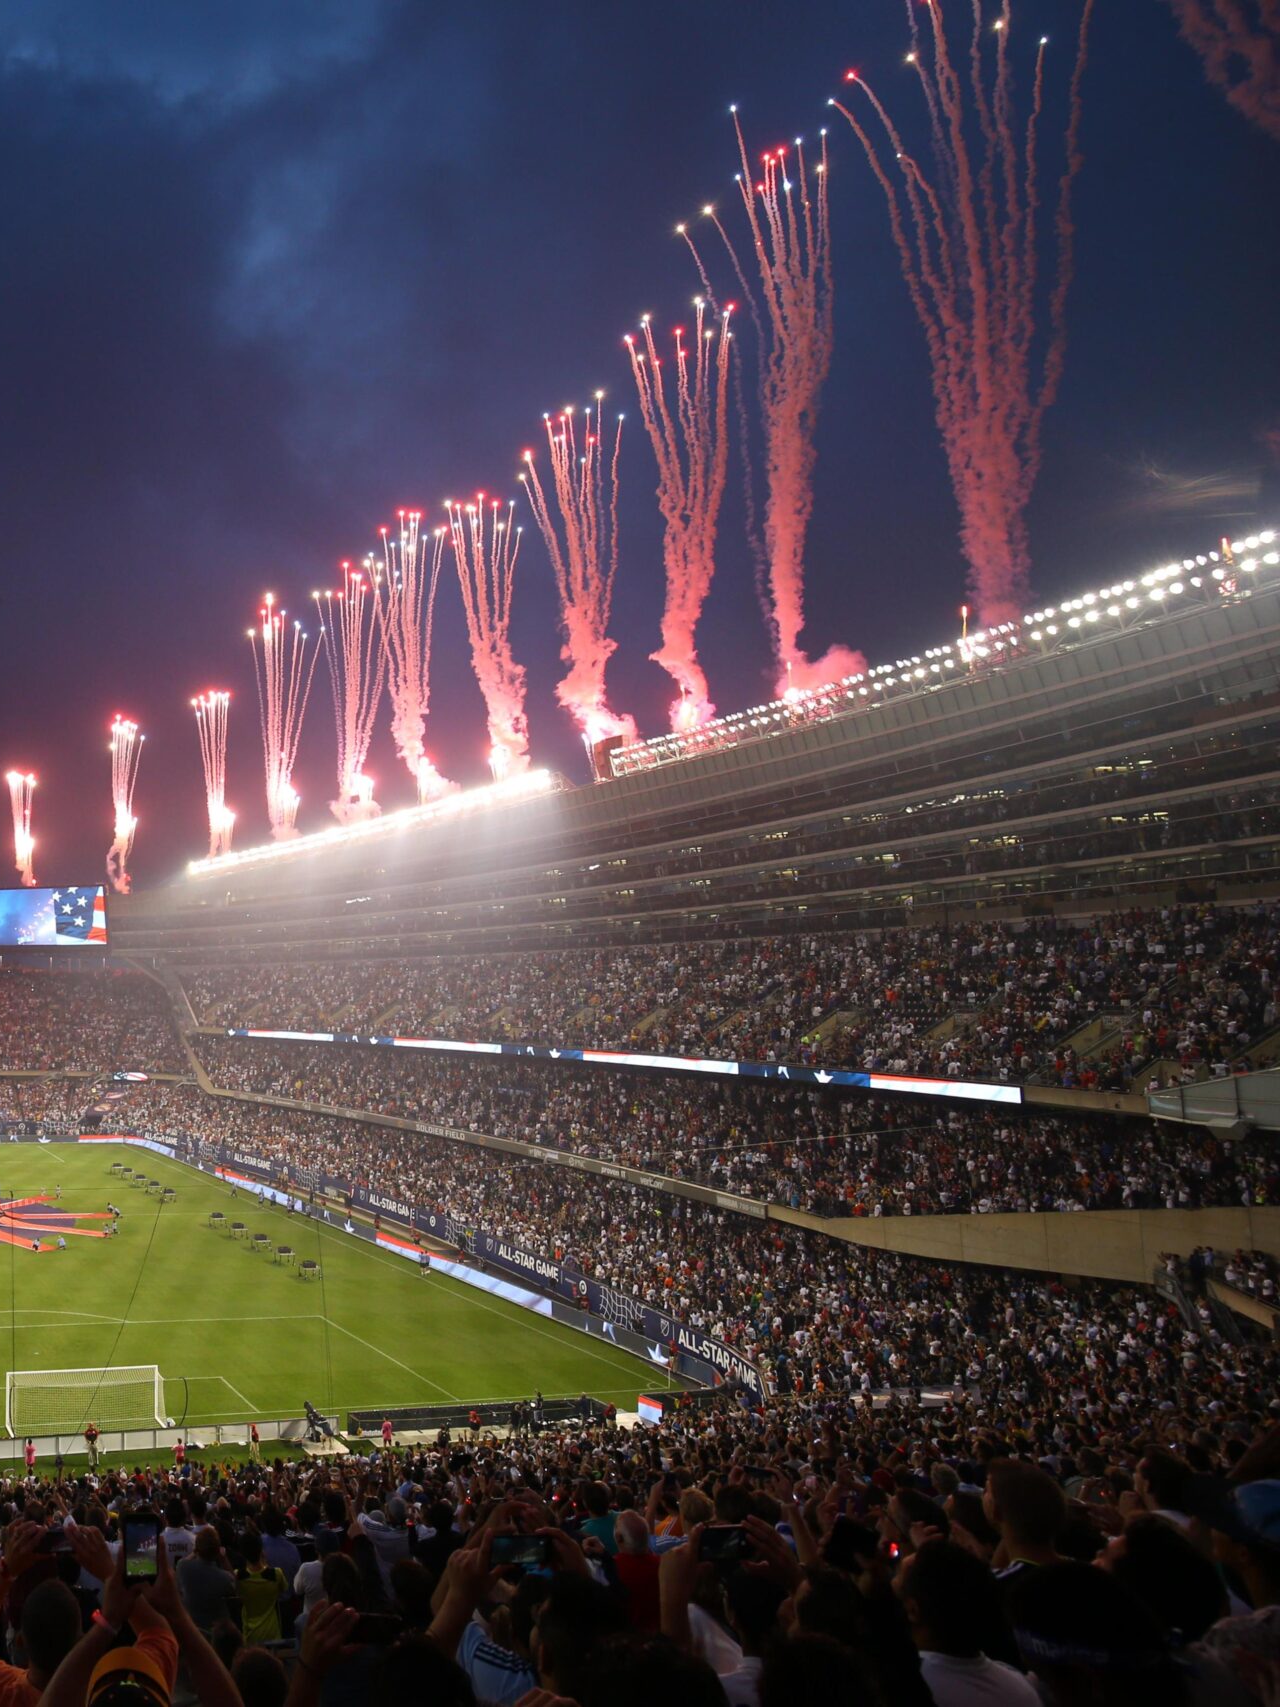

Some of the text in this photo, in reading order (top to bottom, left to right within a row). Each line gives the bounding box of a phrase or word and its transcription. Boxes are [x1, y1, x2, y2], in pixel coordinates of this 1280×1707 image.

[415, 1123, 466, 1141] SOLDIER FIELD
[234, 1153, 257, 1166] ALL-STAR
[257, 1158, 271, 1171] GAME
[369, 1193, 397, 1214] ALL-STAR
[498, 1243, 559, 1282] ALL-STAR GAME
[678, 1328, 730, 1370] ALL-STAR
